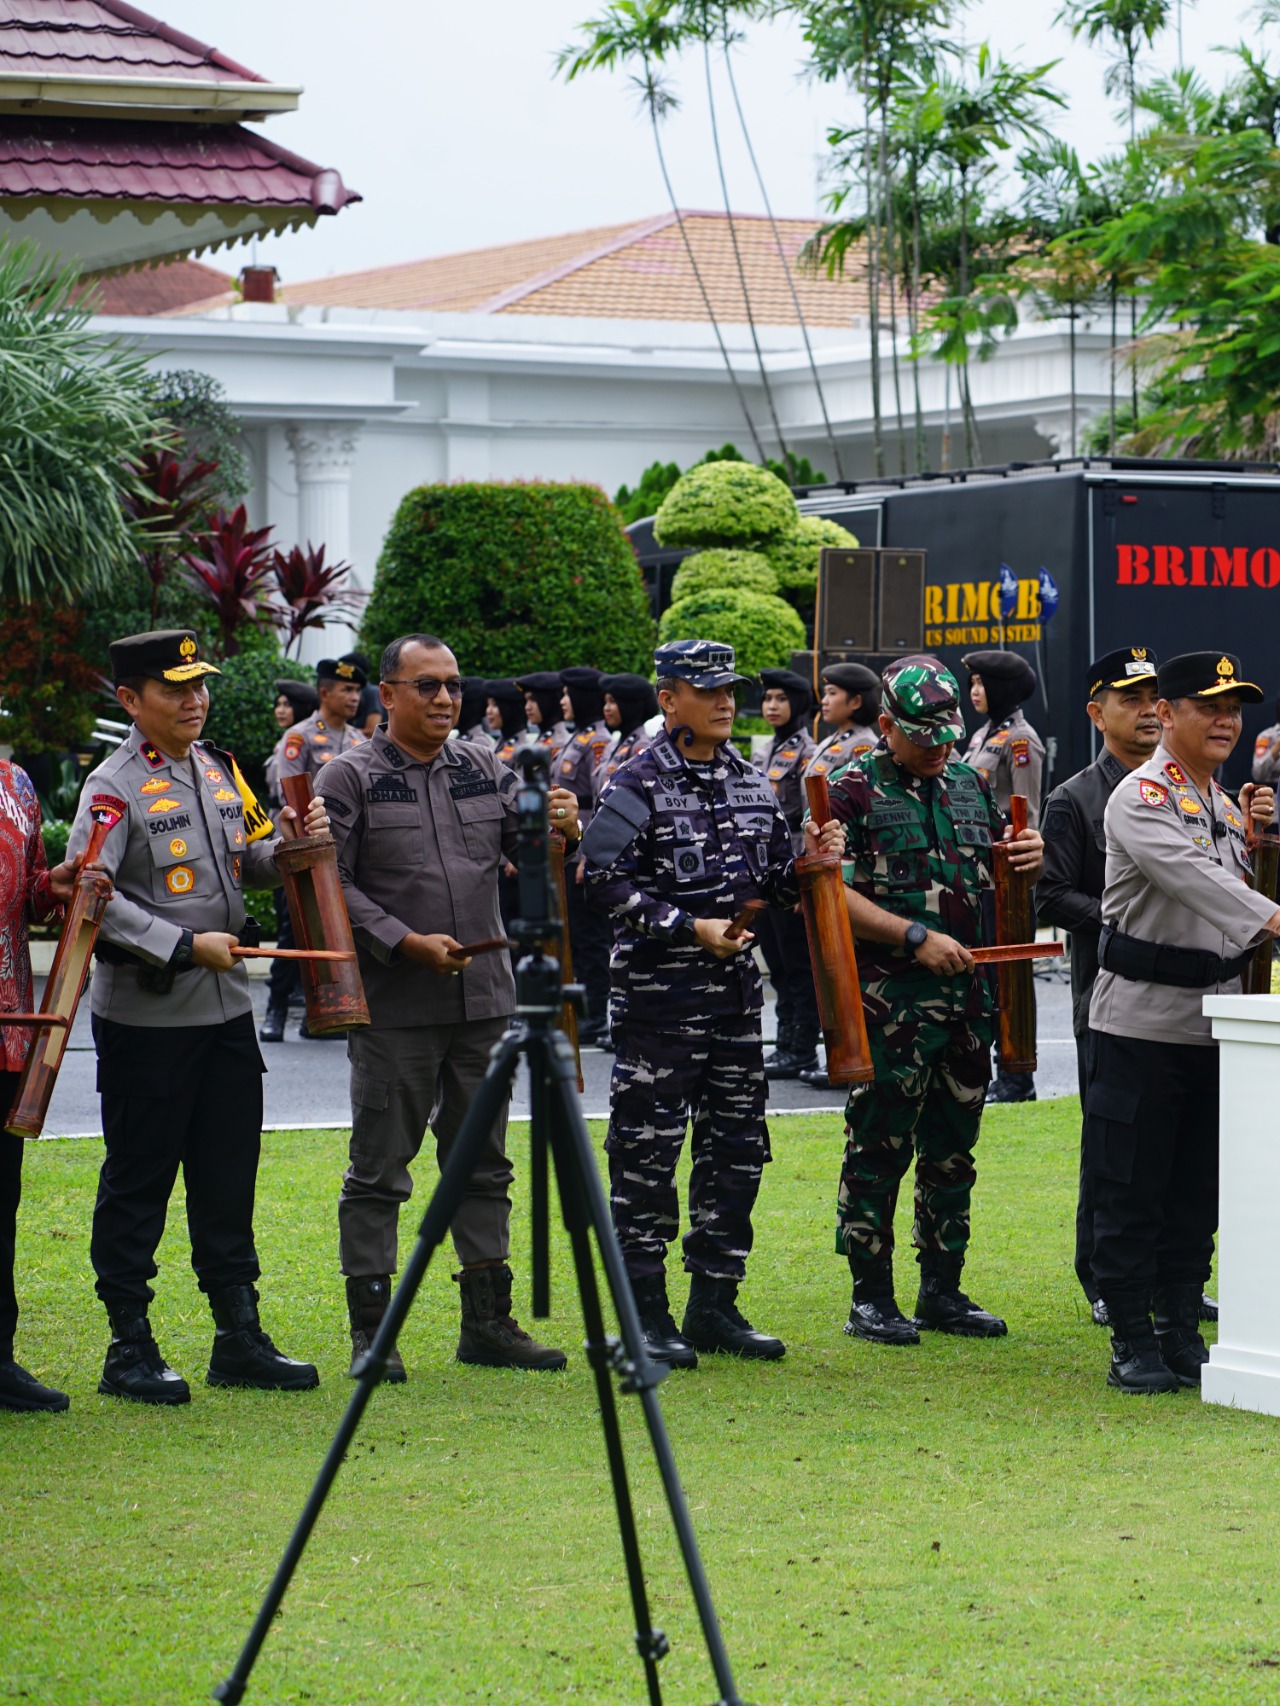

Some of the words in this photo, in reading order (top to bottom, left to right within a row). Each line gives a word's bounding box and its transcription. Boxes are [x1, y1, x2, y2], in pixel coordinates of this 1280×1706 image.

[945, 627, 989, 646] SOUND
[372, 791, 416, 801] DHANI
[733, 794, 754, 804] TNI
[756, 793, 771, 804] AL
[665, 797, 688, 809] BOY
[875, 811, 912, 825] BENNY
[953, 808, 970, 818] TNI
[150, 814, 192, 835] SOLIHIN
